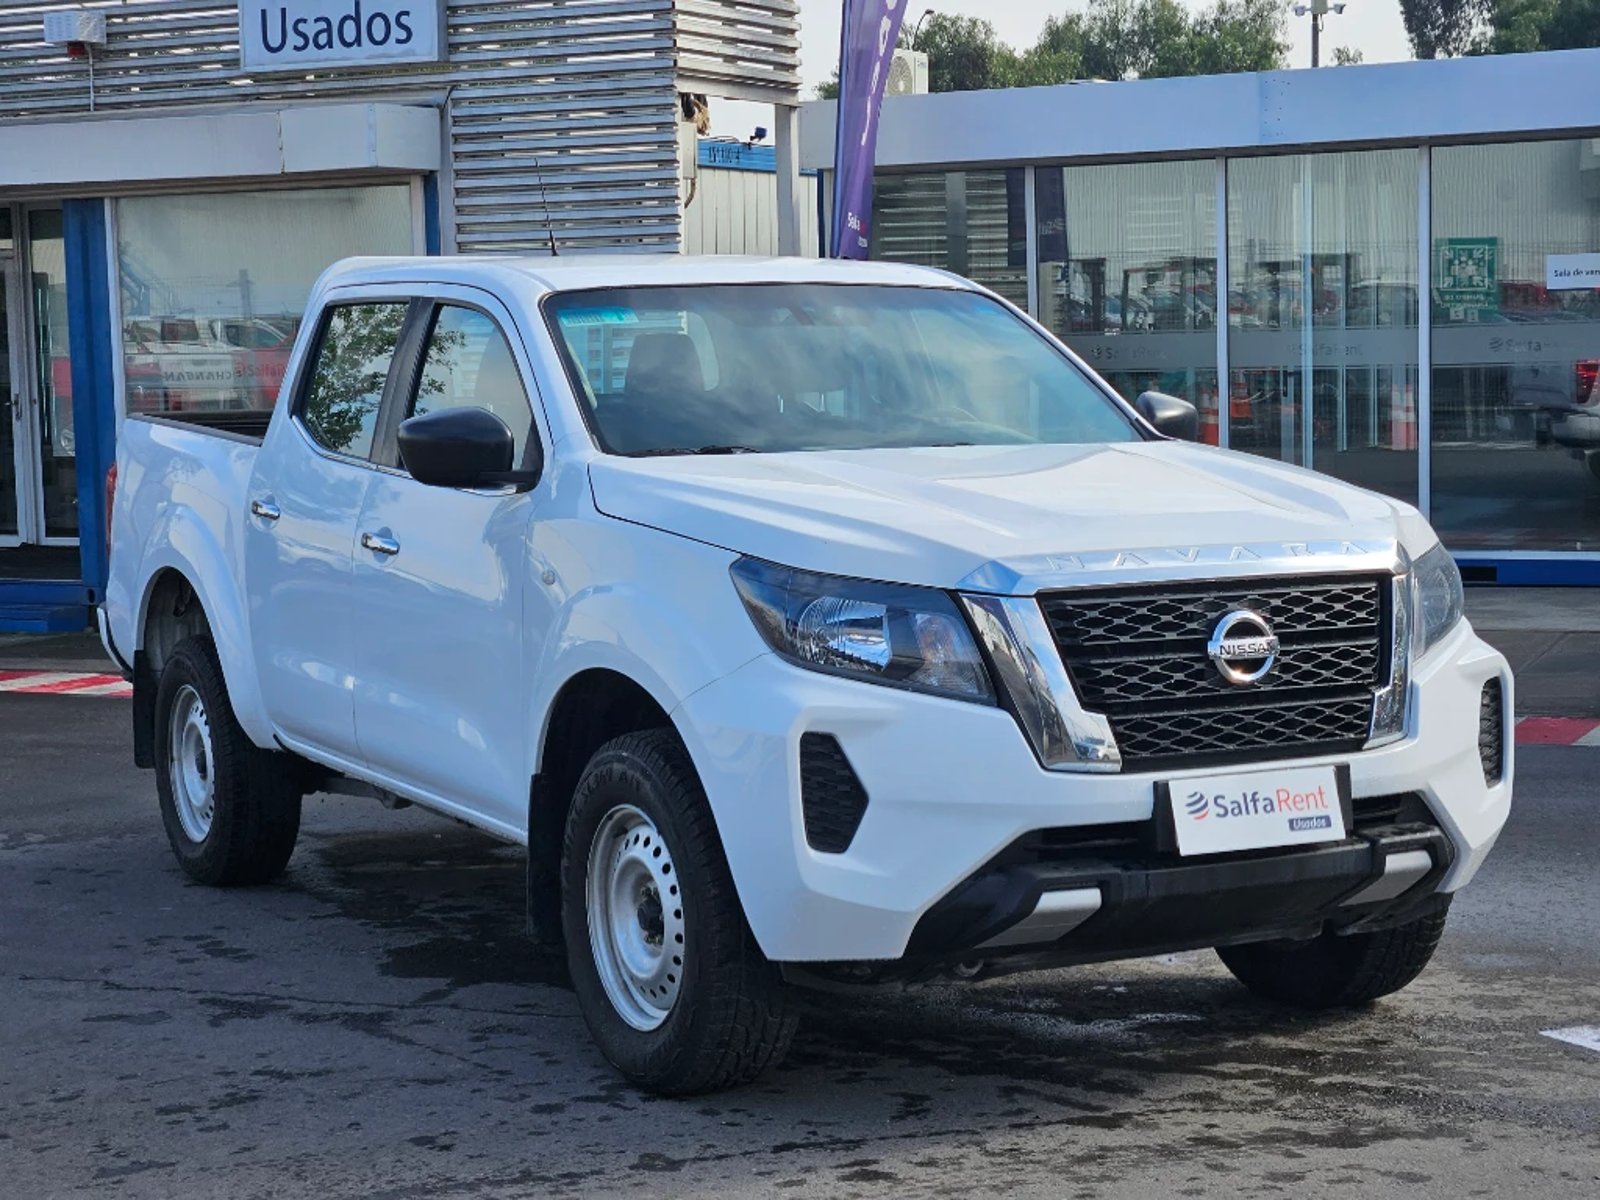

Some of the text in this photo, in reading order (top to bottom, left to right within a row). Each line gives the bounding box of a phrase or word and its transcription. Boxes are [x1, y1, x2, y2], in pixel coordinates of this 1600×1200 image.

[261, 0, 413, 54] Usados
[1046, 541, 1368, 570] NAVARA
[1213, 784, 1329, 819] SalfaRent
[1293, 817, 1327, 830] Usados
